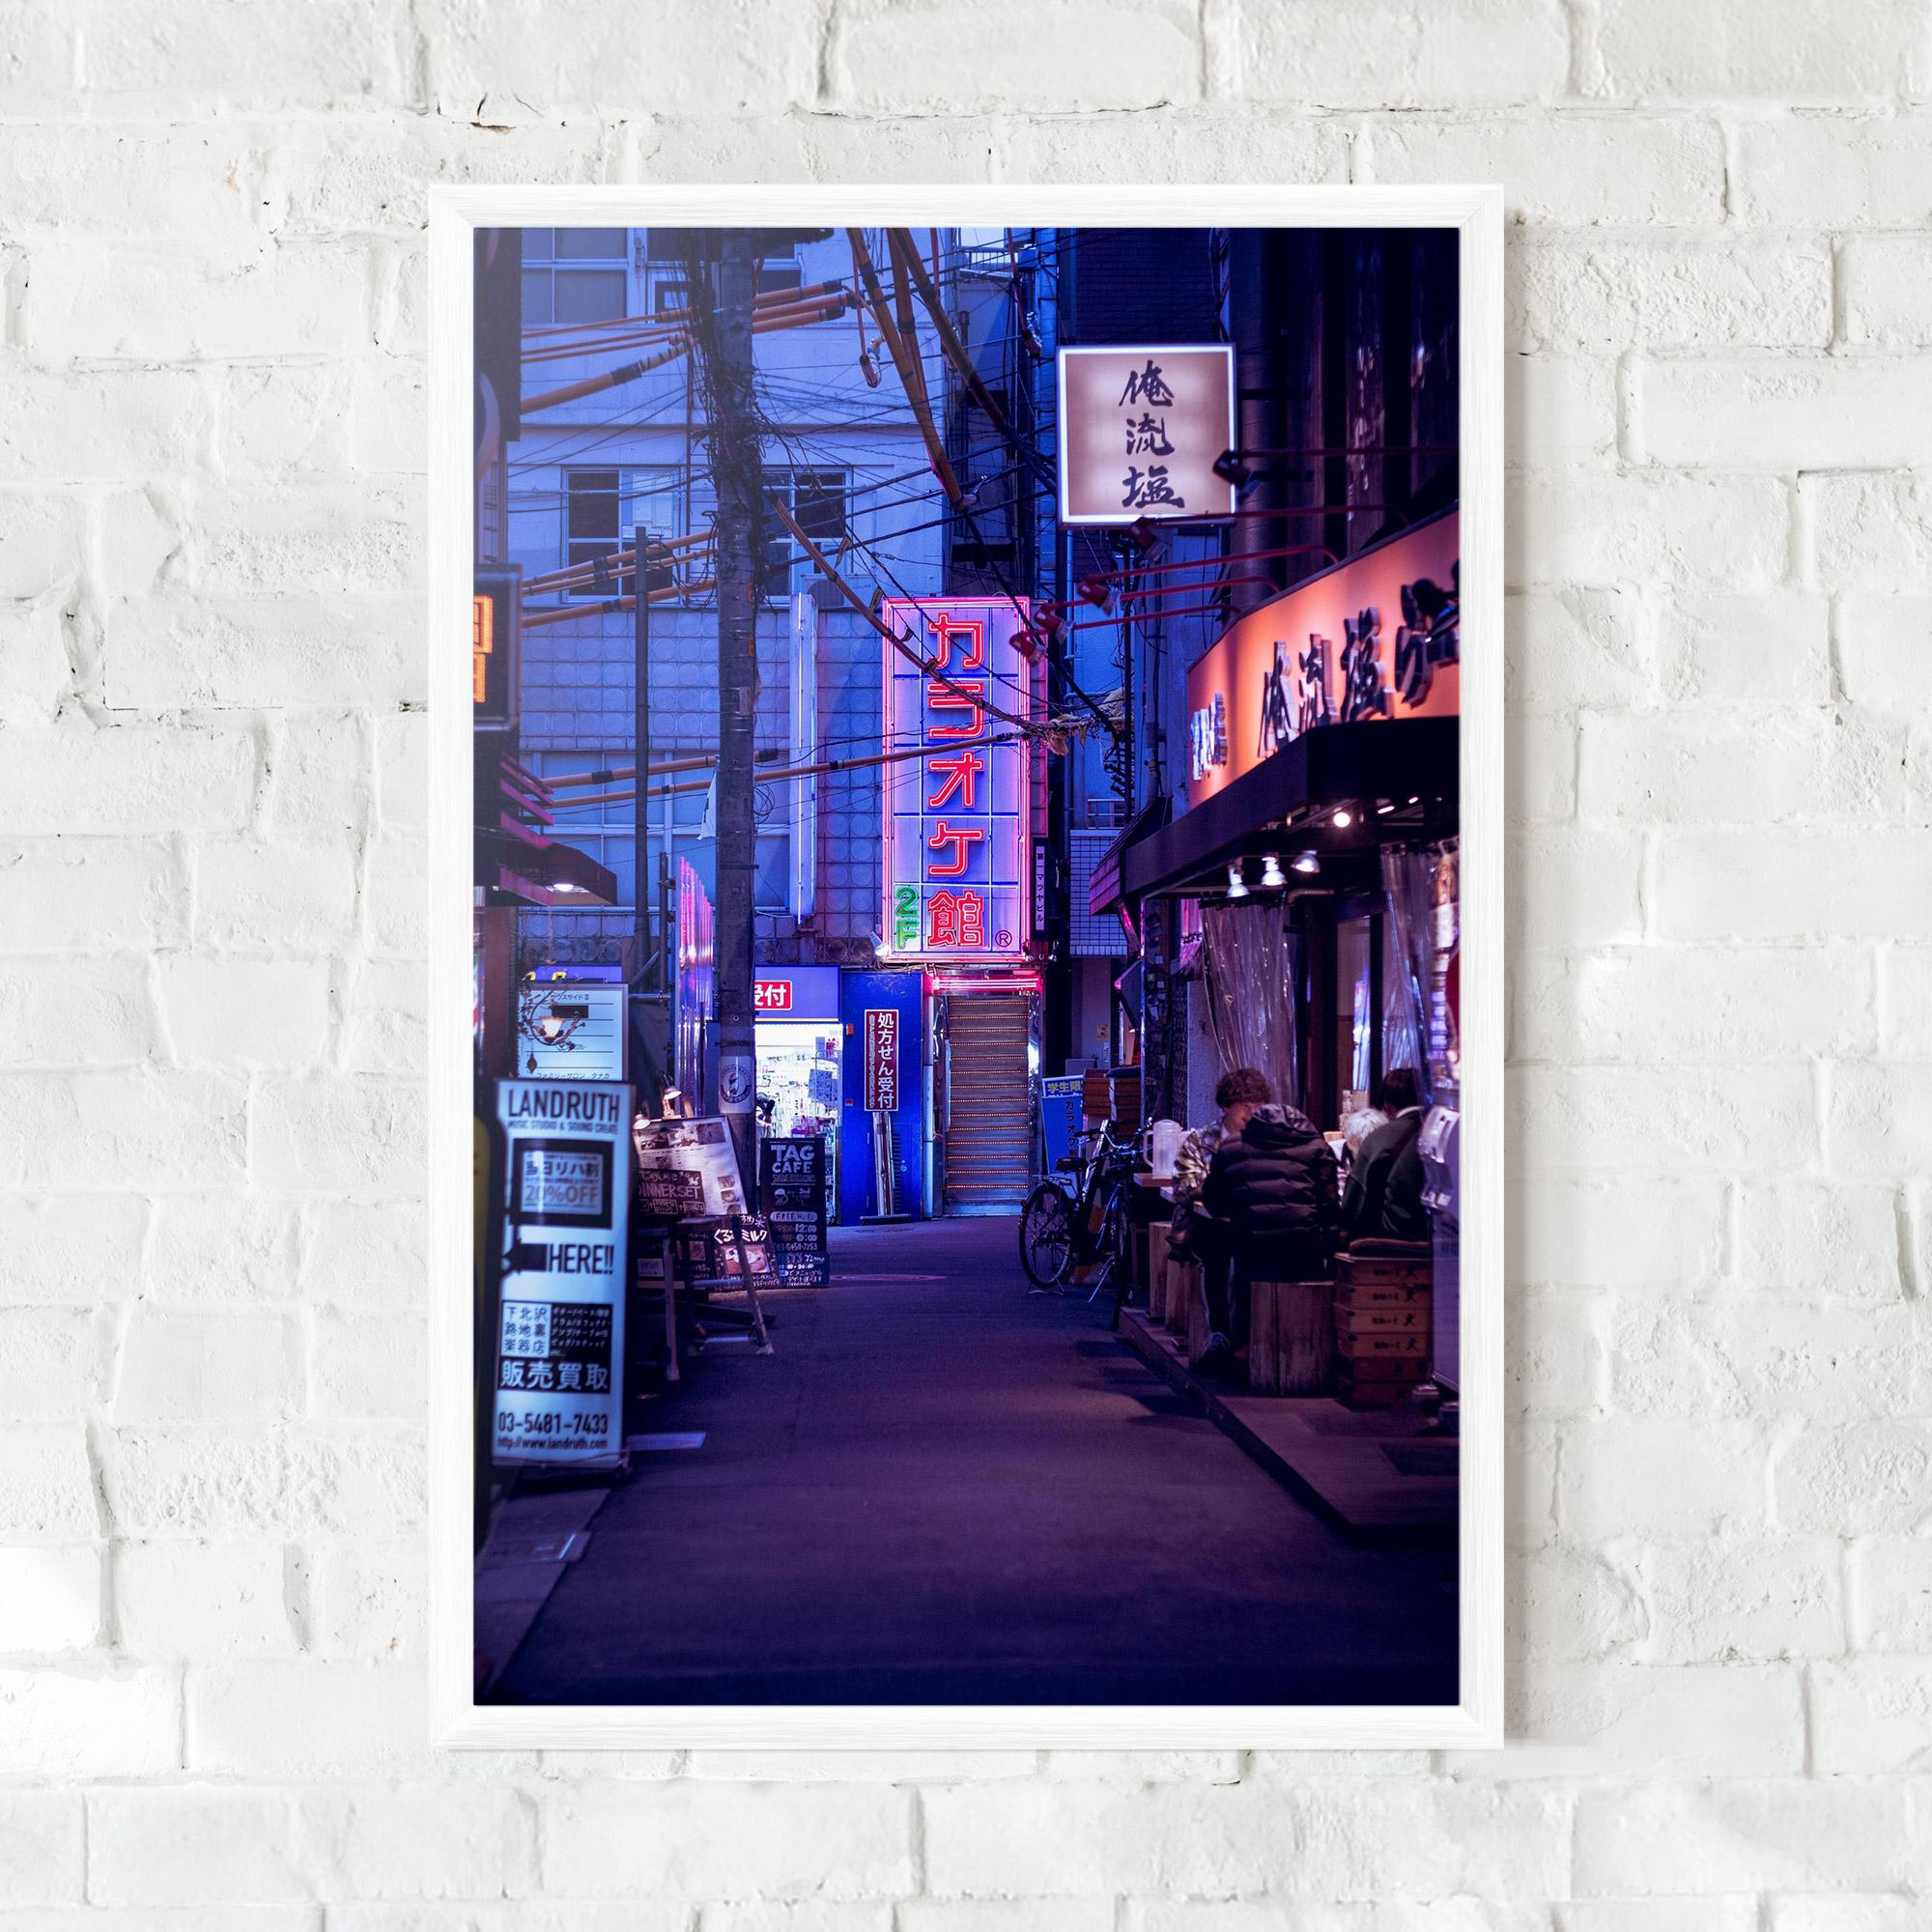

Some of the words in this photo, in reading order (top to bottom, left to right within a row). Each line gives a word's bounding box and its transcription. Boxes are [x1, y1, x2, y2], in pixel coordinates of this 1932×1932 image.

[1118, 359, 1185, 509] 俺流塩
[926, 611, 984, 948] カラオケ館
[877, 1012, 895, 1108] 処方せん受付
[508, 1089, 619, 1122] LANDRUTH
[770, 1144, 815, 1162] TAG
[772, 1161, 812, 1174] CAFE
[548, 1243, 614, 1274] HERE!!
[500, 1359, 609, 1390] 販売買取
[498, 1411, 609, 1435] 03-5481-7433
